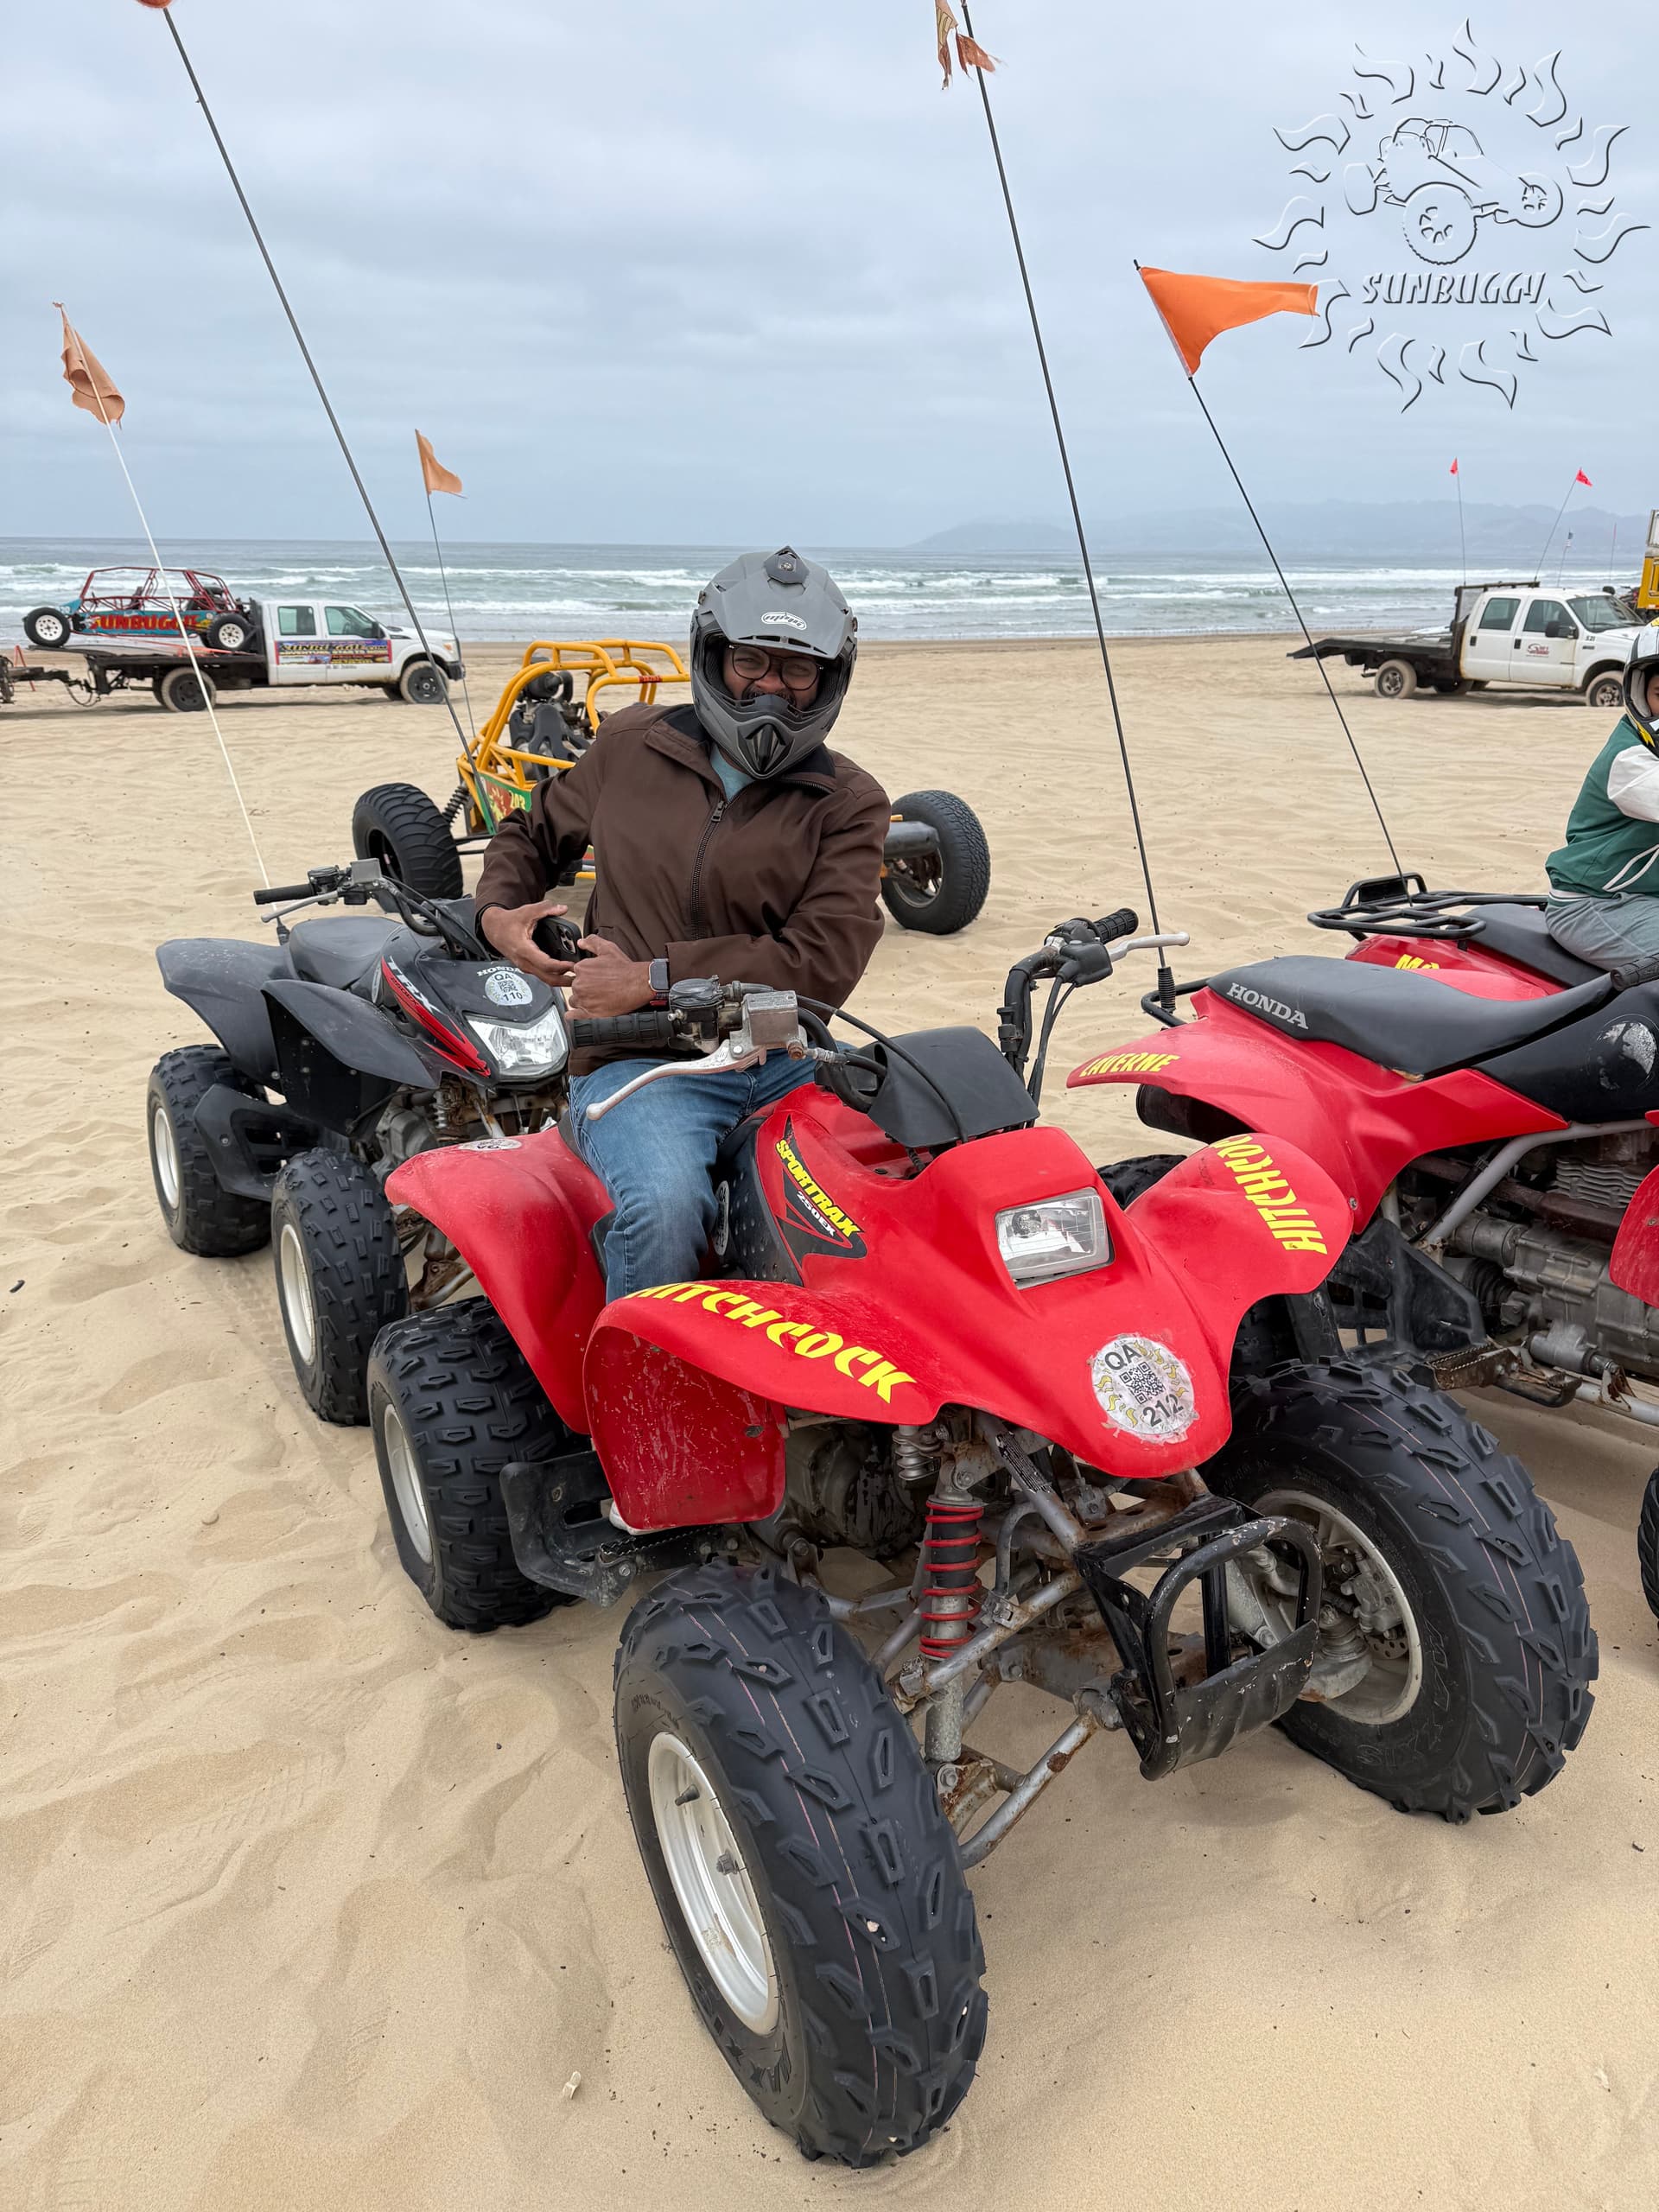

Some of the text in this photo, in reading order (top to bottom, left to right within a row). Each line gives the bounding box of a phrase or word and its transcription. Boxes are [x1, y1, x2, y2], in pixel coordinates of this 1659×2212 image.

[387, 956, 447, 1016] TRX
[477, 966, 525, 976] HONDA
[503, 992, 524, 1001] 110
[1226, 982, 1309, 1030] HONDA
[775, 1139, 863, 1237] SPORTRAX
[1209, 1135, 1328, 1255] HITCHCOC
[797, 1191, 836, 1236] 250EX
[623, 1282, 917, 1403] HITCHCOCK
[1104, 1344, 1142, 1370] QA
[1142, 1393, 1185, 1427] 212
